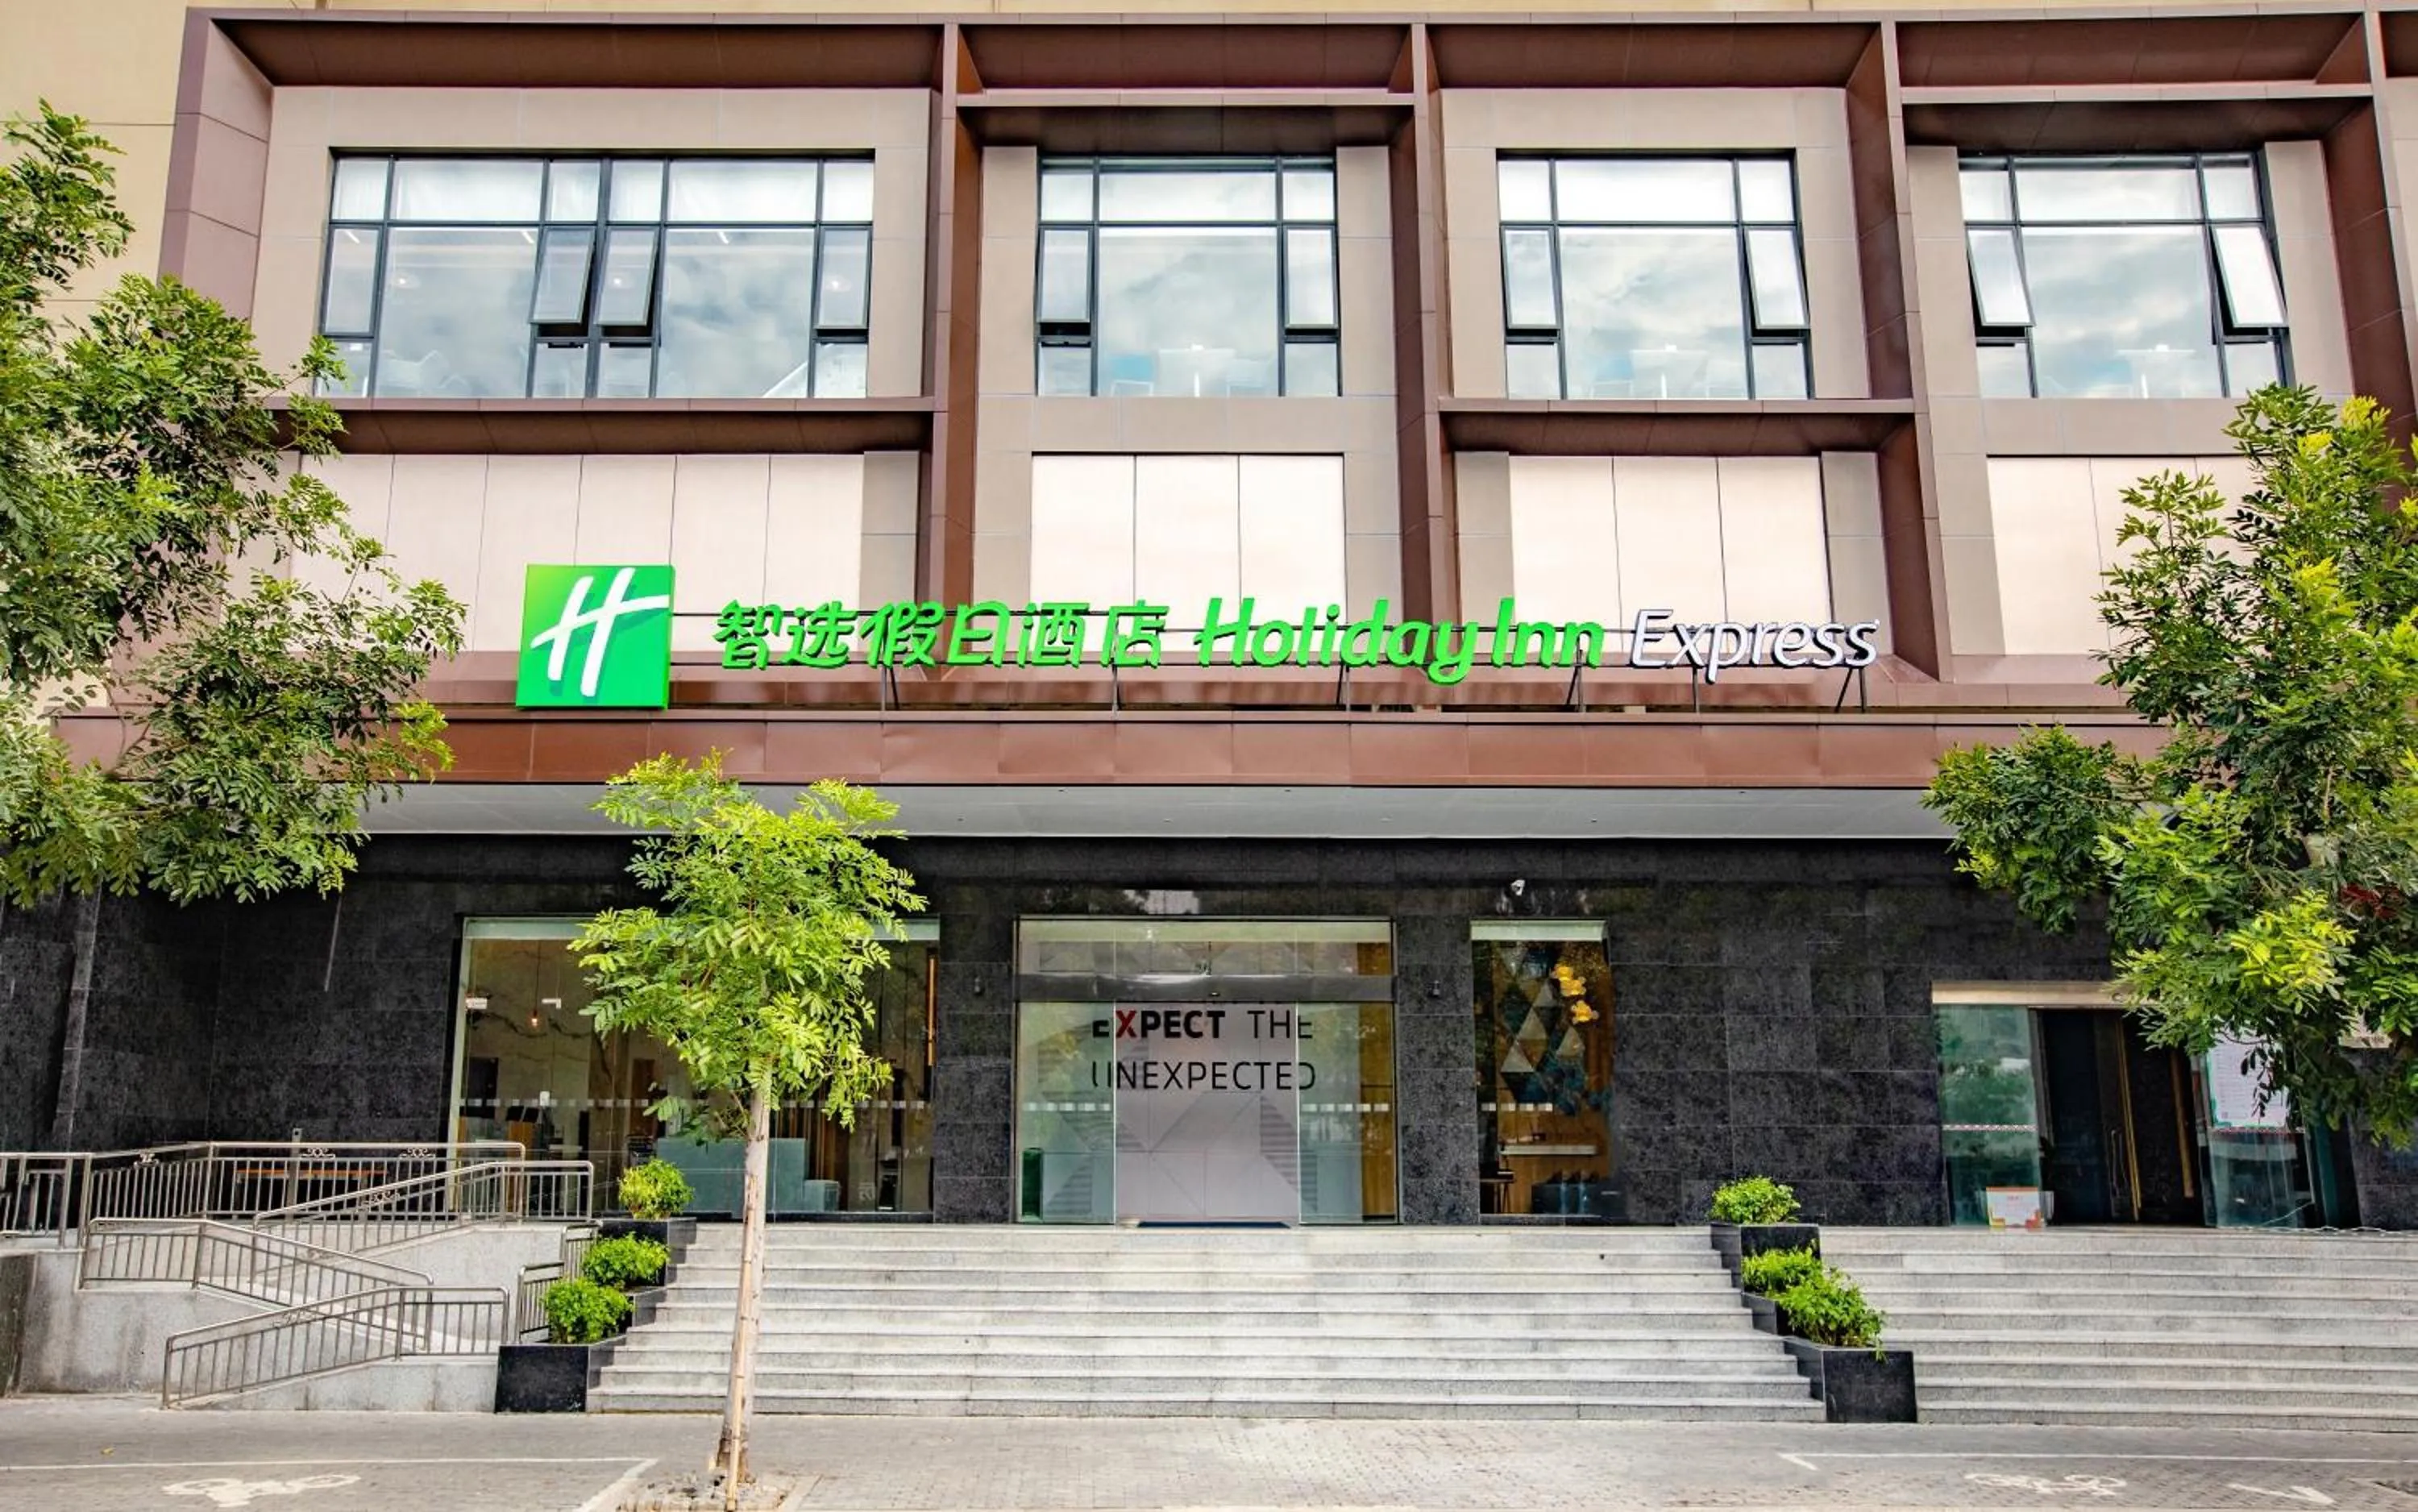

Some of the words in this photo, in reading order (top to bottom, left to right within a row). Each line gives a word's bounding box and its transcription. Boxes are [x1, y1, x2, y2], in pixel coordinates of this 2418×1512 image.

[713, 600, 1169, 671] 智选假日酒店
[1194, 597, 1479, 687] Holiday
[1490, 597, 1604, 669] Inn
[1631, 608, 1880, 685] Express
[1092, 1010, 1226, 1039] EXPECT
[1247, 1010, 1312, 1039] THE
[1092, 1061, 1316, 1090] UNEXPECTED
